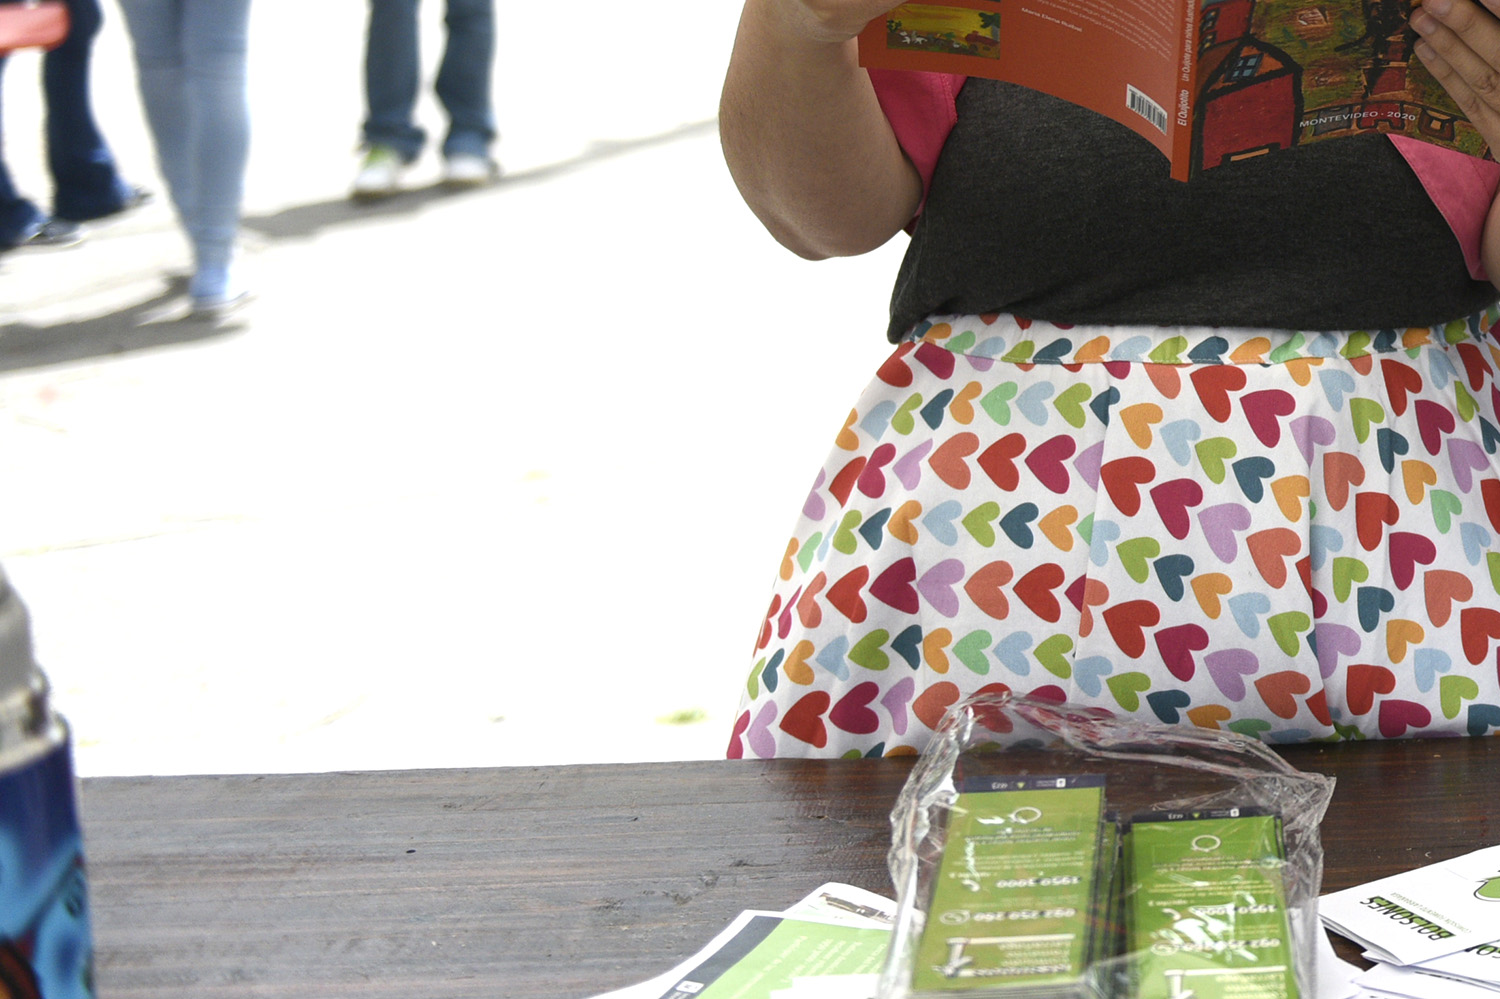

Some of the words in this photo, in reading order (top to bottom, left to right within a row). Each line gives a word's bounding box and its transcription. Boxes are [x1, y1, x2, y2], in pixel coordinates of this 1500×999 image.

[1178, 89, 1190, 116] Quijotito
[1177, 117, 1187, 127] El
[1299, 110, 1378, 128] MONTEVIDEO
[1387, 111, 1416, 121] 2020
[1360, 896, 1456, 941] BOLSONES
